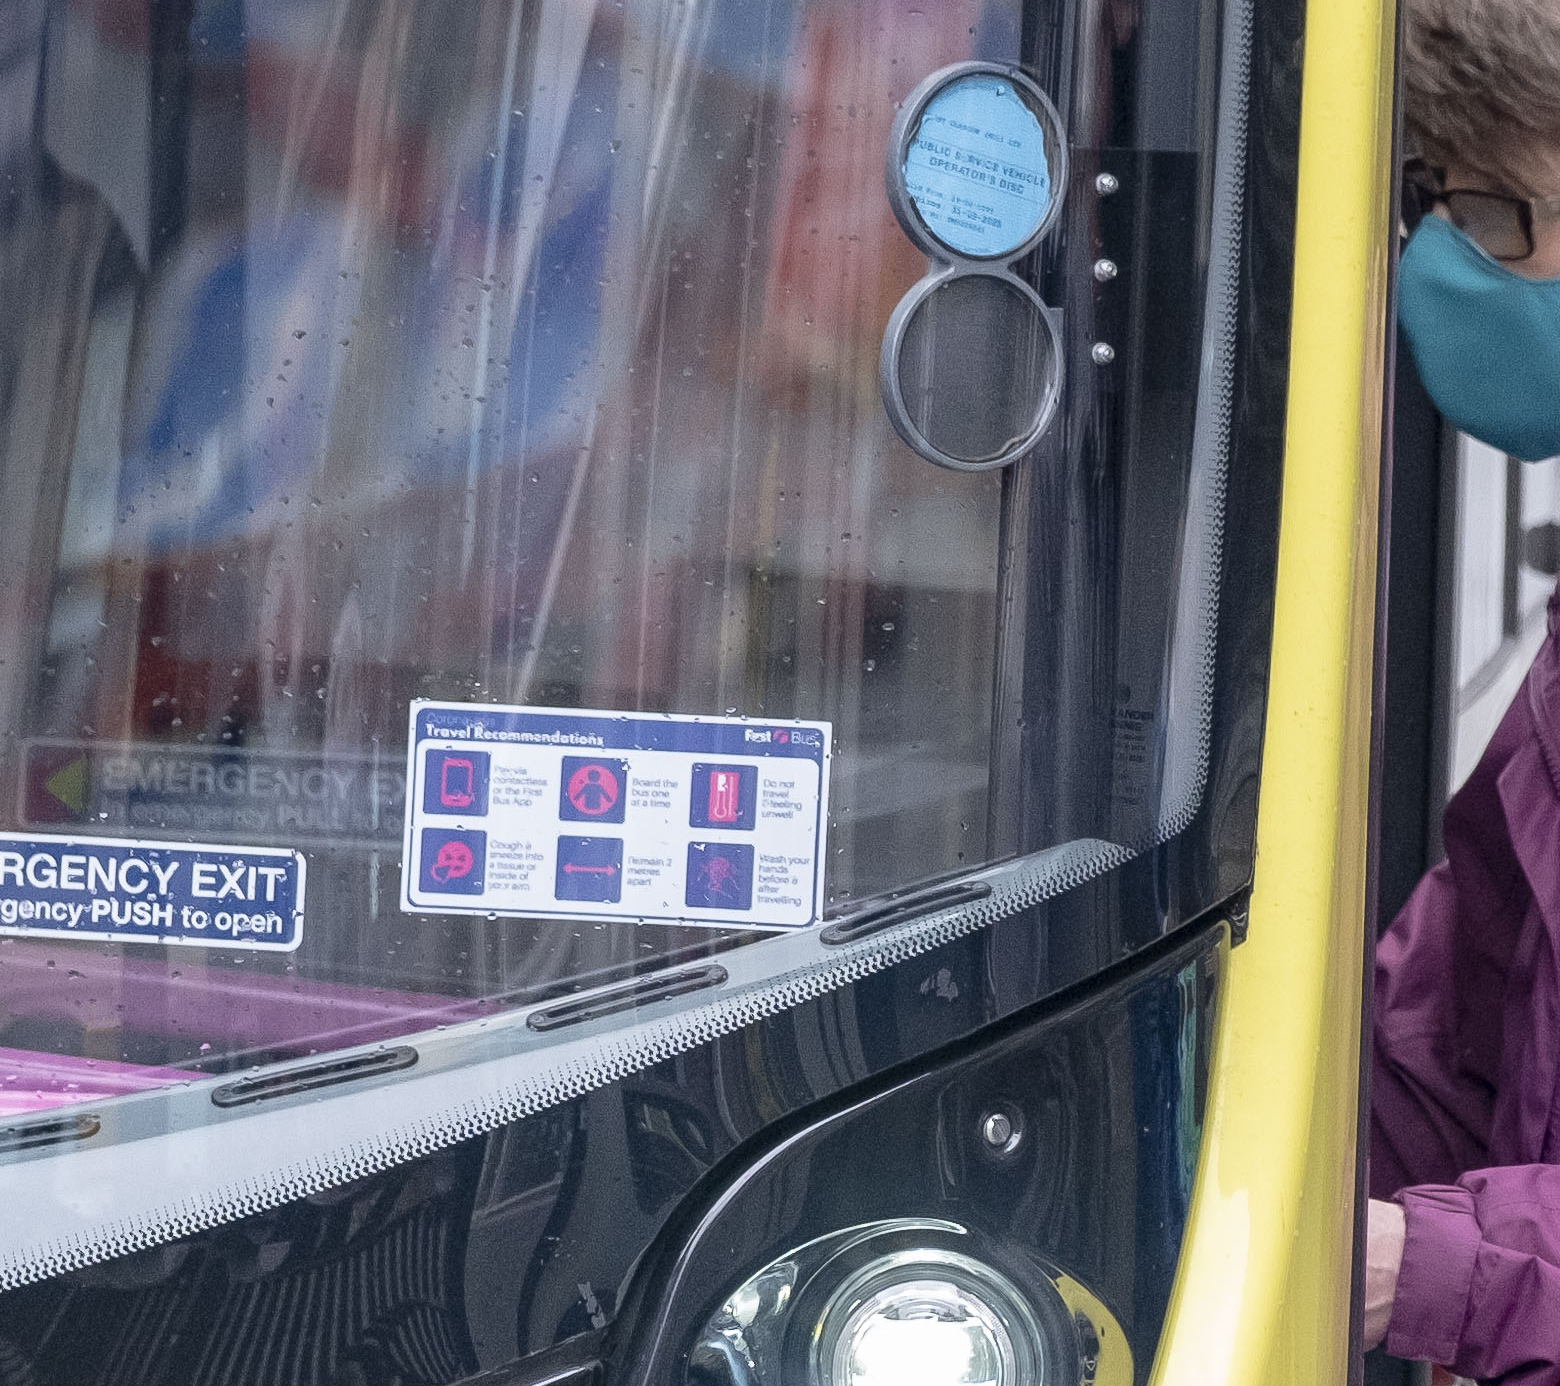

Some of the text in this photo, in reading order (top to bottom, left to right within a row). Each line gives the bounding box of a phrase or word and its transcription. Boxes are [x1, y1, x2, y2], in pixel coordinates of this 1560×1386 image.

[425, 723, 605, 746] Travel Recommendations
[191, 861, 286, 902] EXIT
[92, 899, 173, 928] PUSH
[182, 910, 209, 929] to
[213, 912, 284, 936] open
